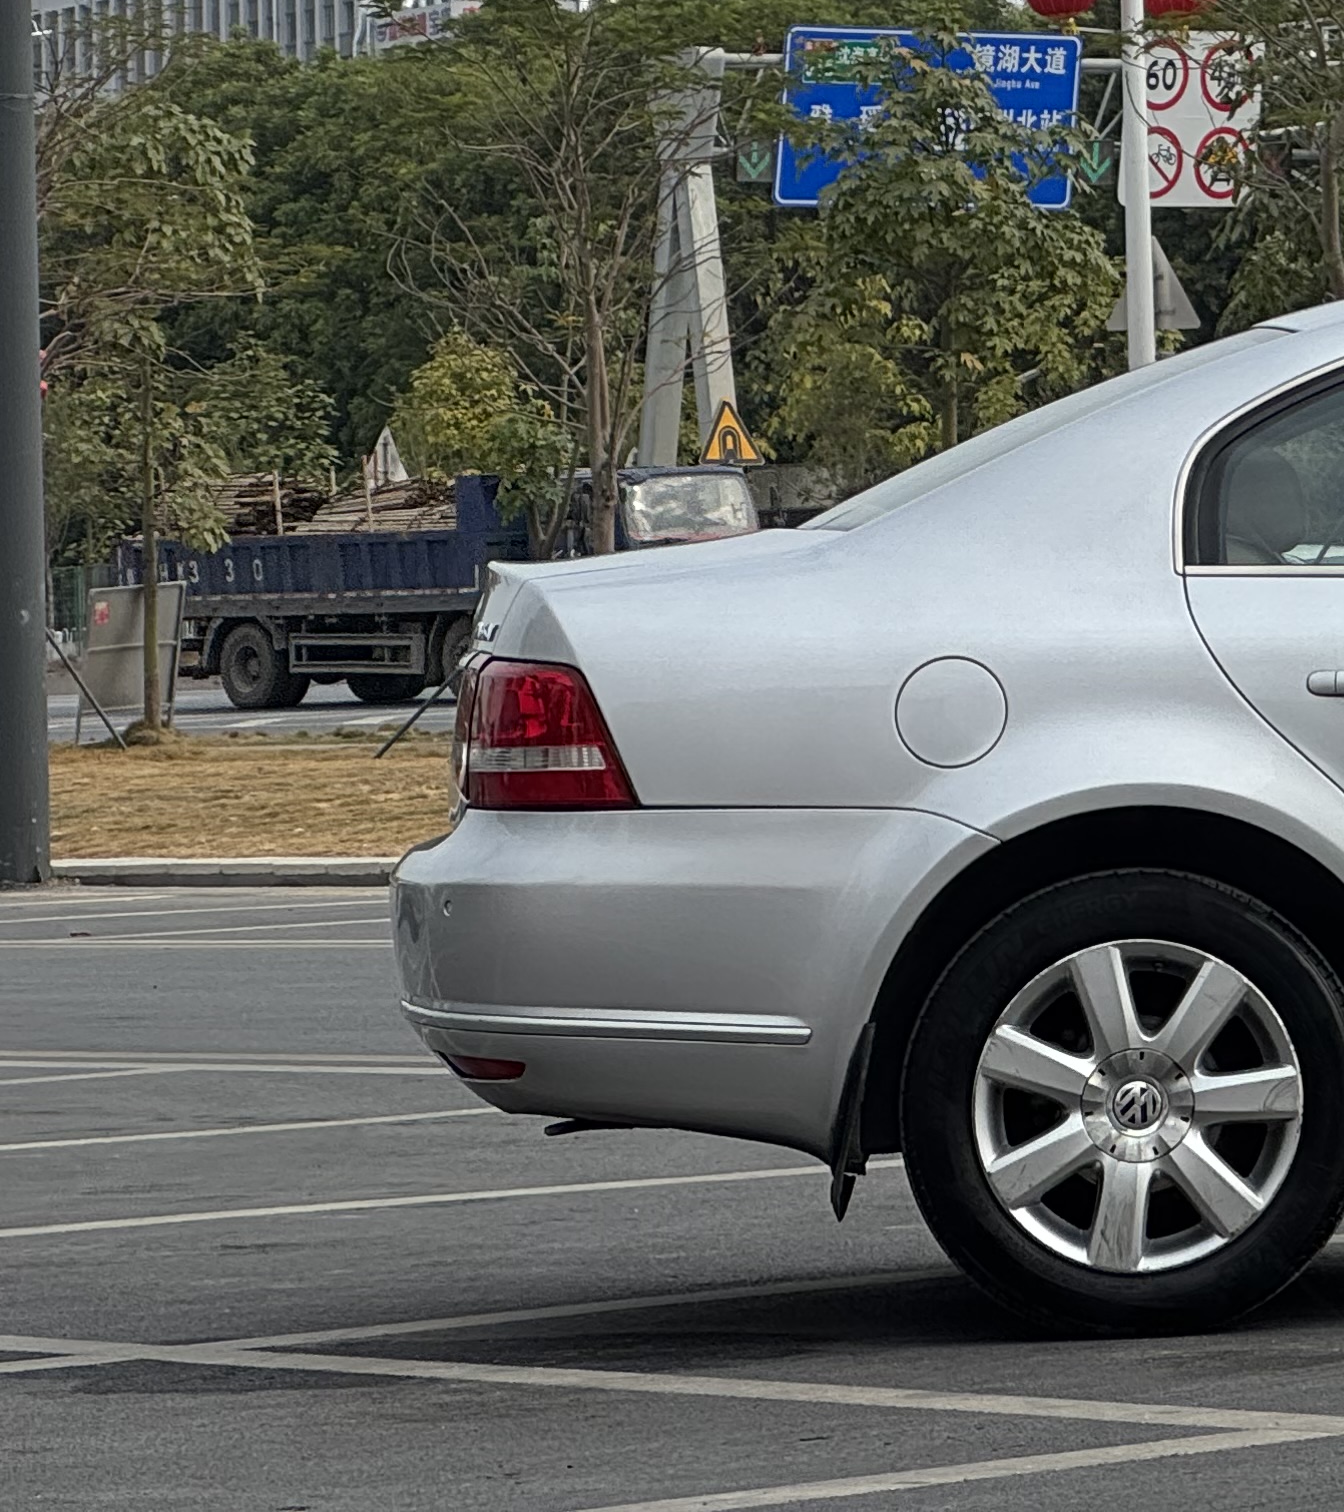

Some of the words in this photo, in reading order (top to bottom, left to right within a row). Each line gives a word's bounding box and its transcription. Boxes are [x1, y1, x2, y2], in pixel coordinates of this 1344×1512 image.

[974, 44, 1067, 75] 镜湖大道
[1145, 59, 1177, 91] 60
